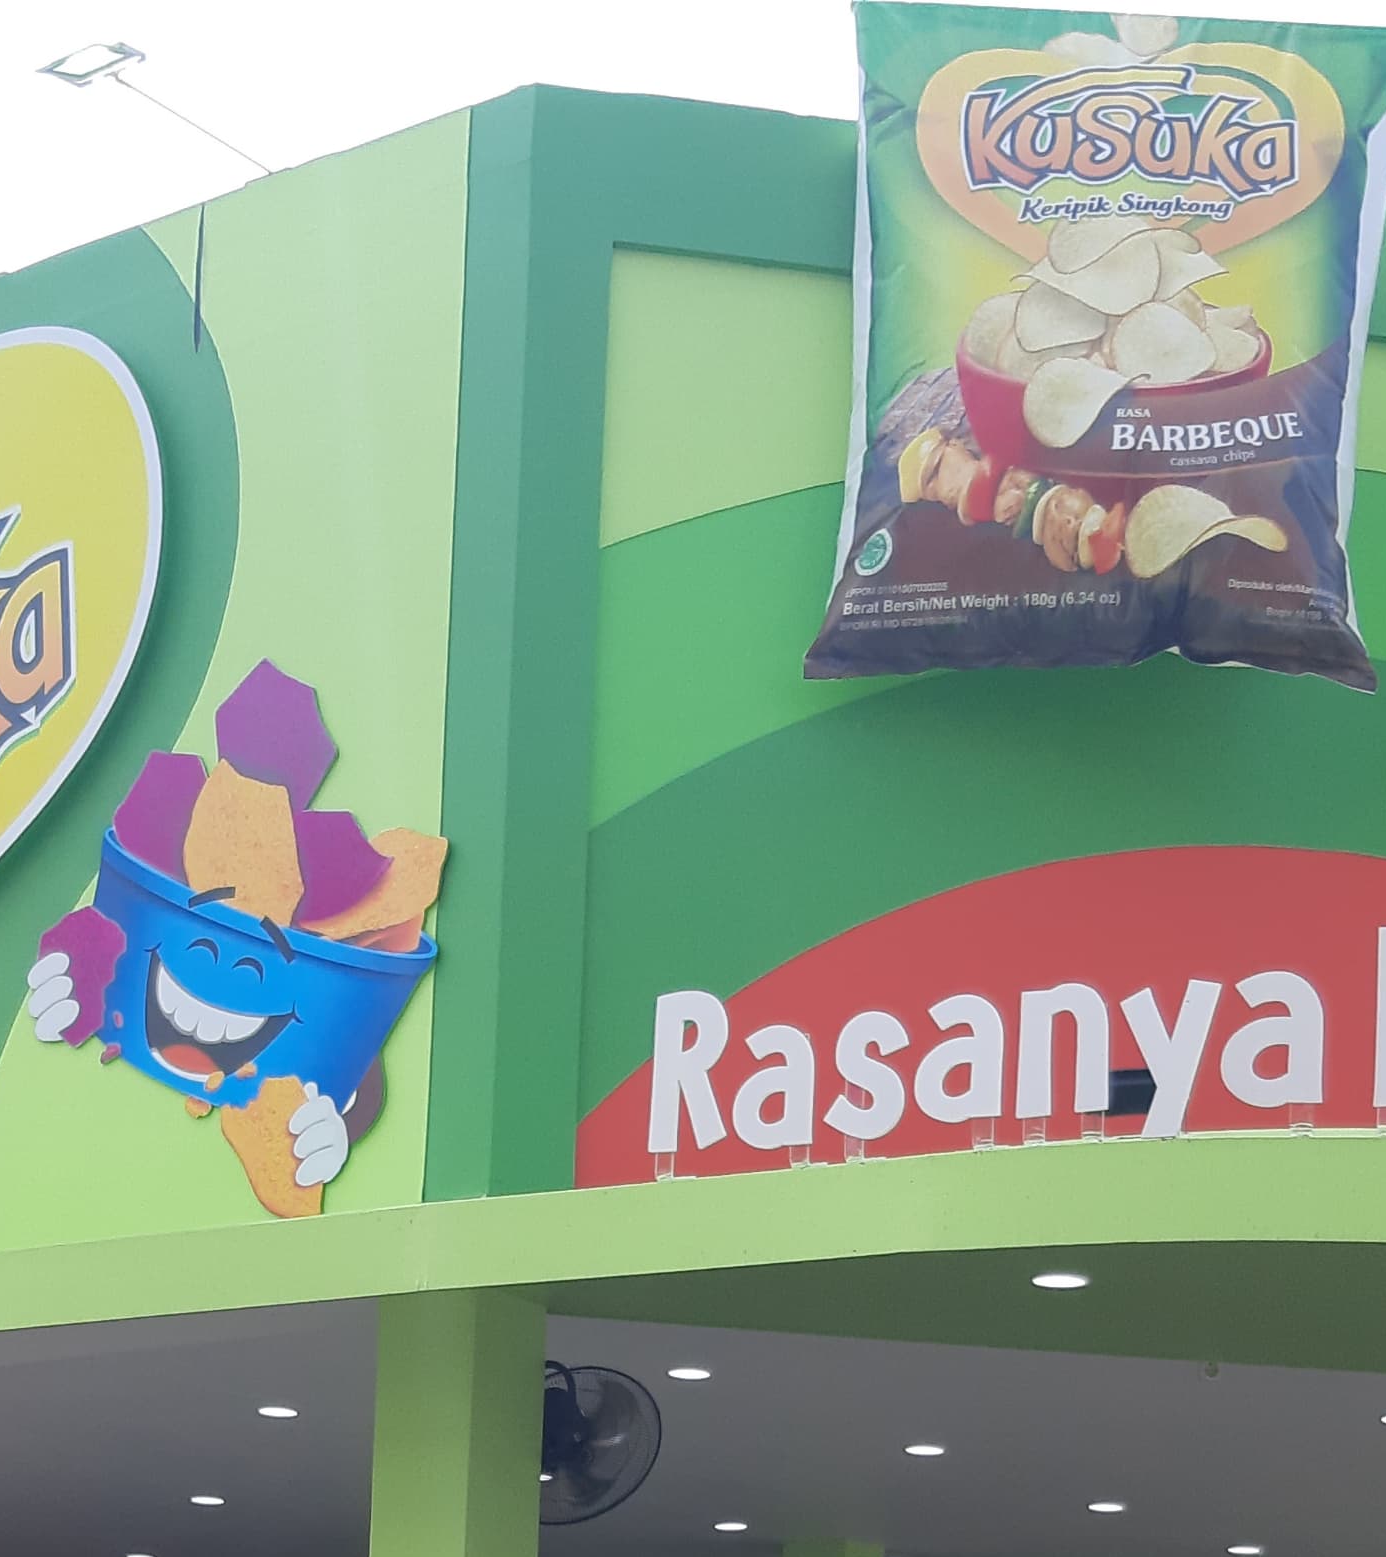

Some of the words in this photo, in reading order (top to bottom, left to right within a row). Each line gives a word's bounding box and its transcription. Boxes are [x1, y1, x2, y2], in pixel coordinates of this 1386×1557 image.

[1020, 194, 1111, 222] Keripik
[1117, 192, 1232, 223] Singkong
[1116, 408, 1151, 418] RASA
[1111, 412, 1303, 452] BARBEQUE
[1170, 455, 1218, 466] cassava
[1223, 450, 1256, 464] chips
[843, 602, 879, 616] Berat
[961, 594, 1010, 610] Weight
[1023, 593, 1057, 608] 180g
[648, 971, 1324, 1154] Rasanya
